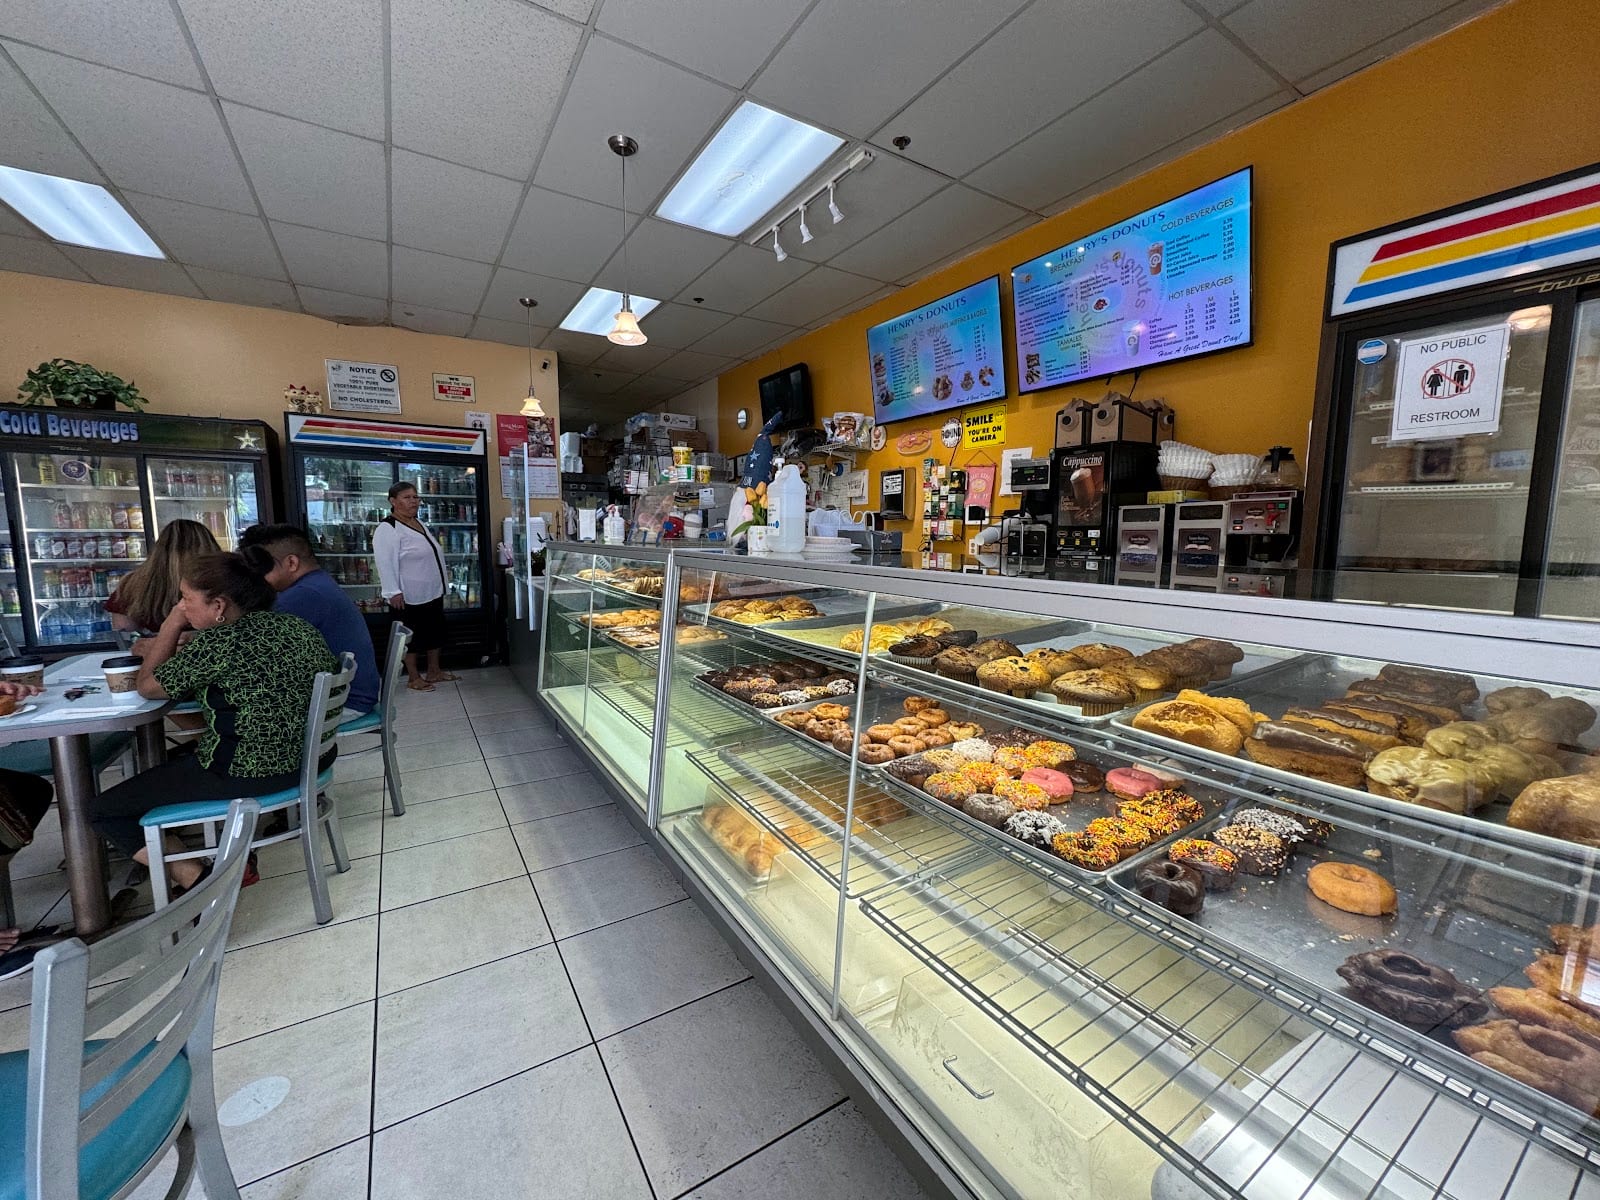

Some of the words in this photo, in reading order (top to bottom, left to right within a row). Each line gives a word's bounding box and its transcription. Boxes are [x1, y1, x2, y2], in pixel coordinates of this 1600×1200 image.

[1161, 218, 1183, 232] COLD
[1186, 198, 1234, 222] BEVERAGES
[1112, 211, 1166, 240] DONUTS
[1050, 255, 1085, 274] BREAKFAST
[1169, 291, 1184, 301] HOT
[1186, 276, 1233, 296] BEVERAGES
[887, 313, 924, 335] HENRY'S
[926, 296, 967, 320] DONUTS
[1057, 335, 1082, 347] TAMALES
[1183, 343, 1200, 354] Great
[1202, 338, 1222, 347] Donut
[1224, 332, 1243, 343] Day!
[1420, 342, 1438, 353] NO
[1441, 334, 1487, 351] PUBLIC
[349, 366, 376, 374] NOTICE
[966, 414, 994, 427] SMILE
[1411, 408, 1480, 424] RESTROOM
[0, 410, 40, 435] Cold
[47, 414, 139, 443] Beverages
[968, 427, 990, 436] YOU'RE
[1063, 454, 1102, 468] Cappuccino
